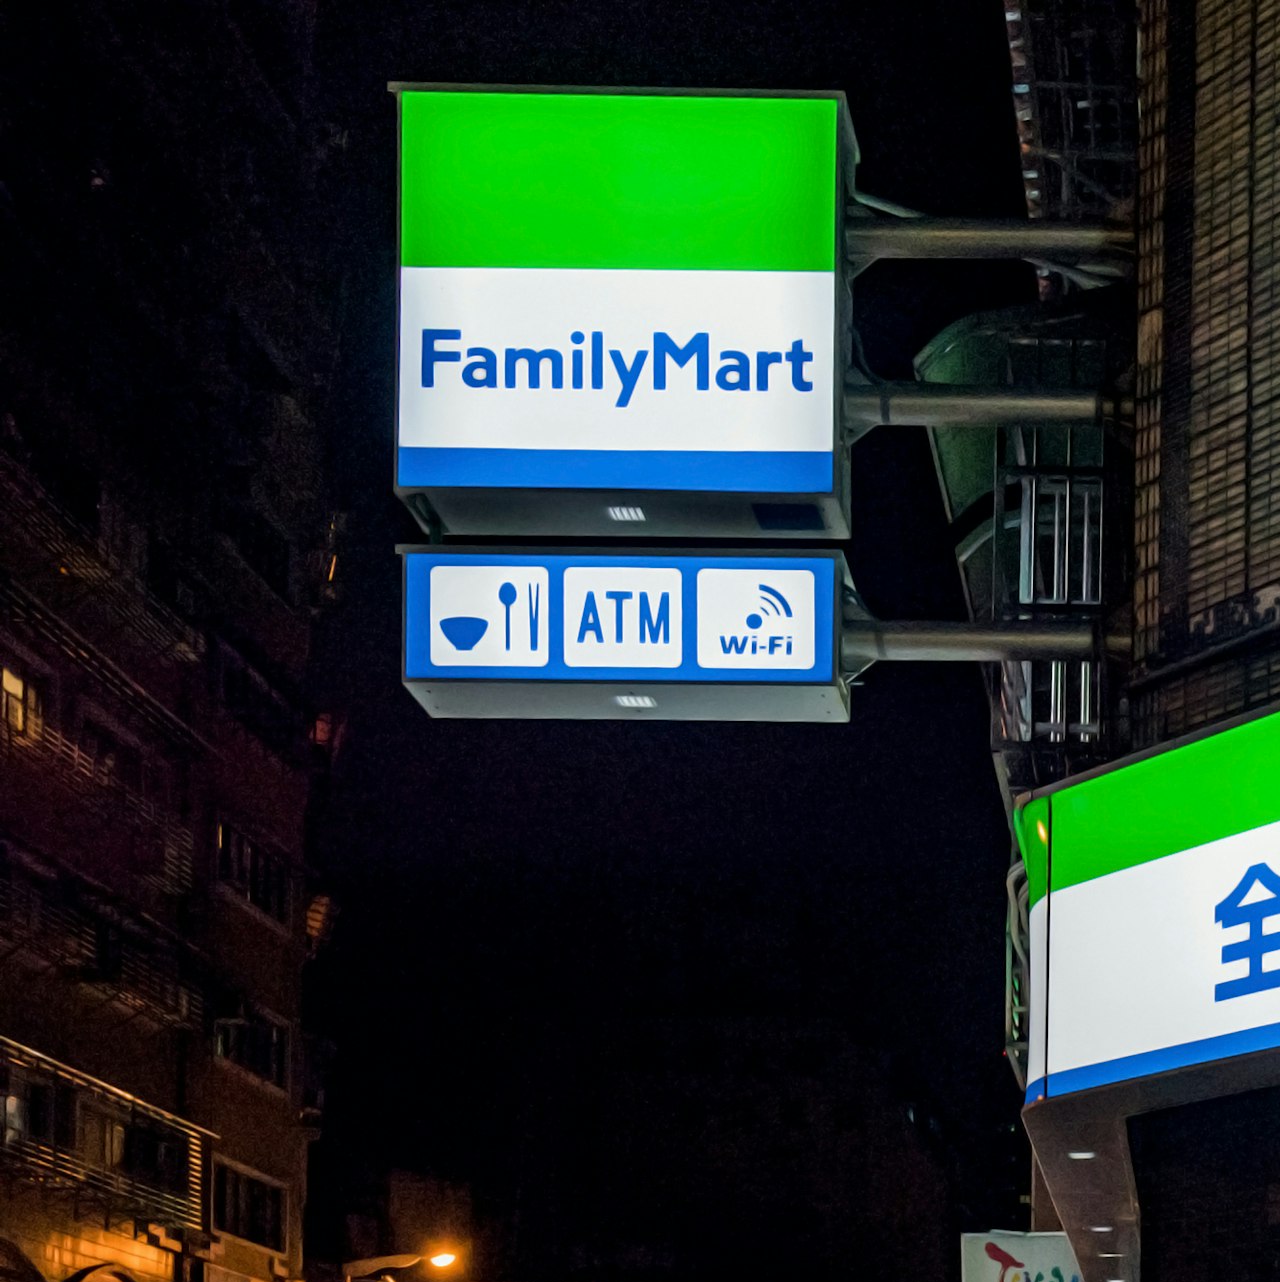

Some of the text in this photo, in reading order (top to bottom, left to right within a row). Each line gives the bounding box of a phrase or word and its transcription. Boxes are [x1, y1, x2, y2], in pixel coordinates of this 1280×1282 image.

[421, 328, 814, 408] FamilyMart
[576, 590, 670, 644] ATM
[719, 635, 793, 656] Wi-Fi
